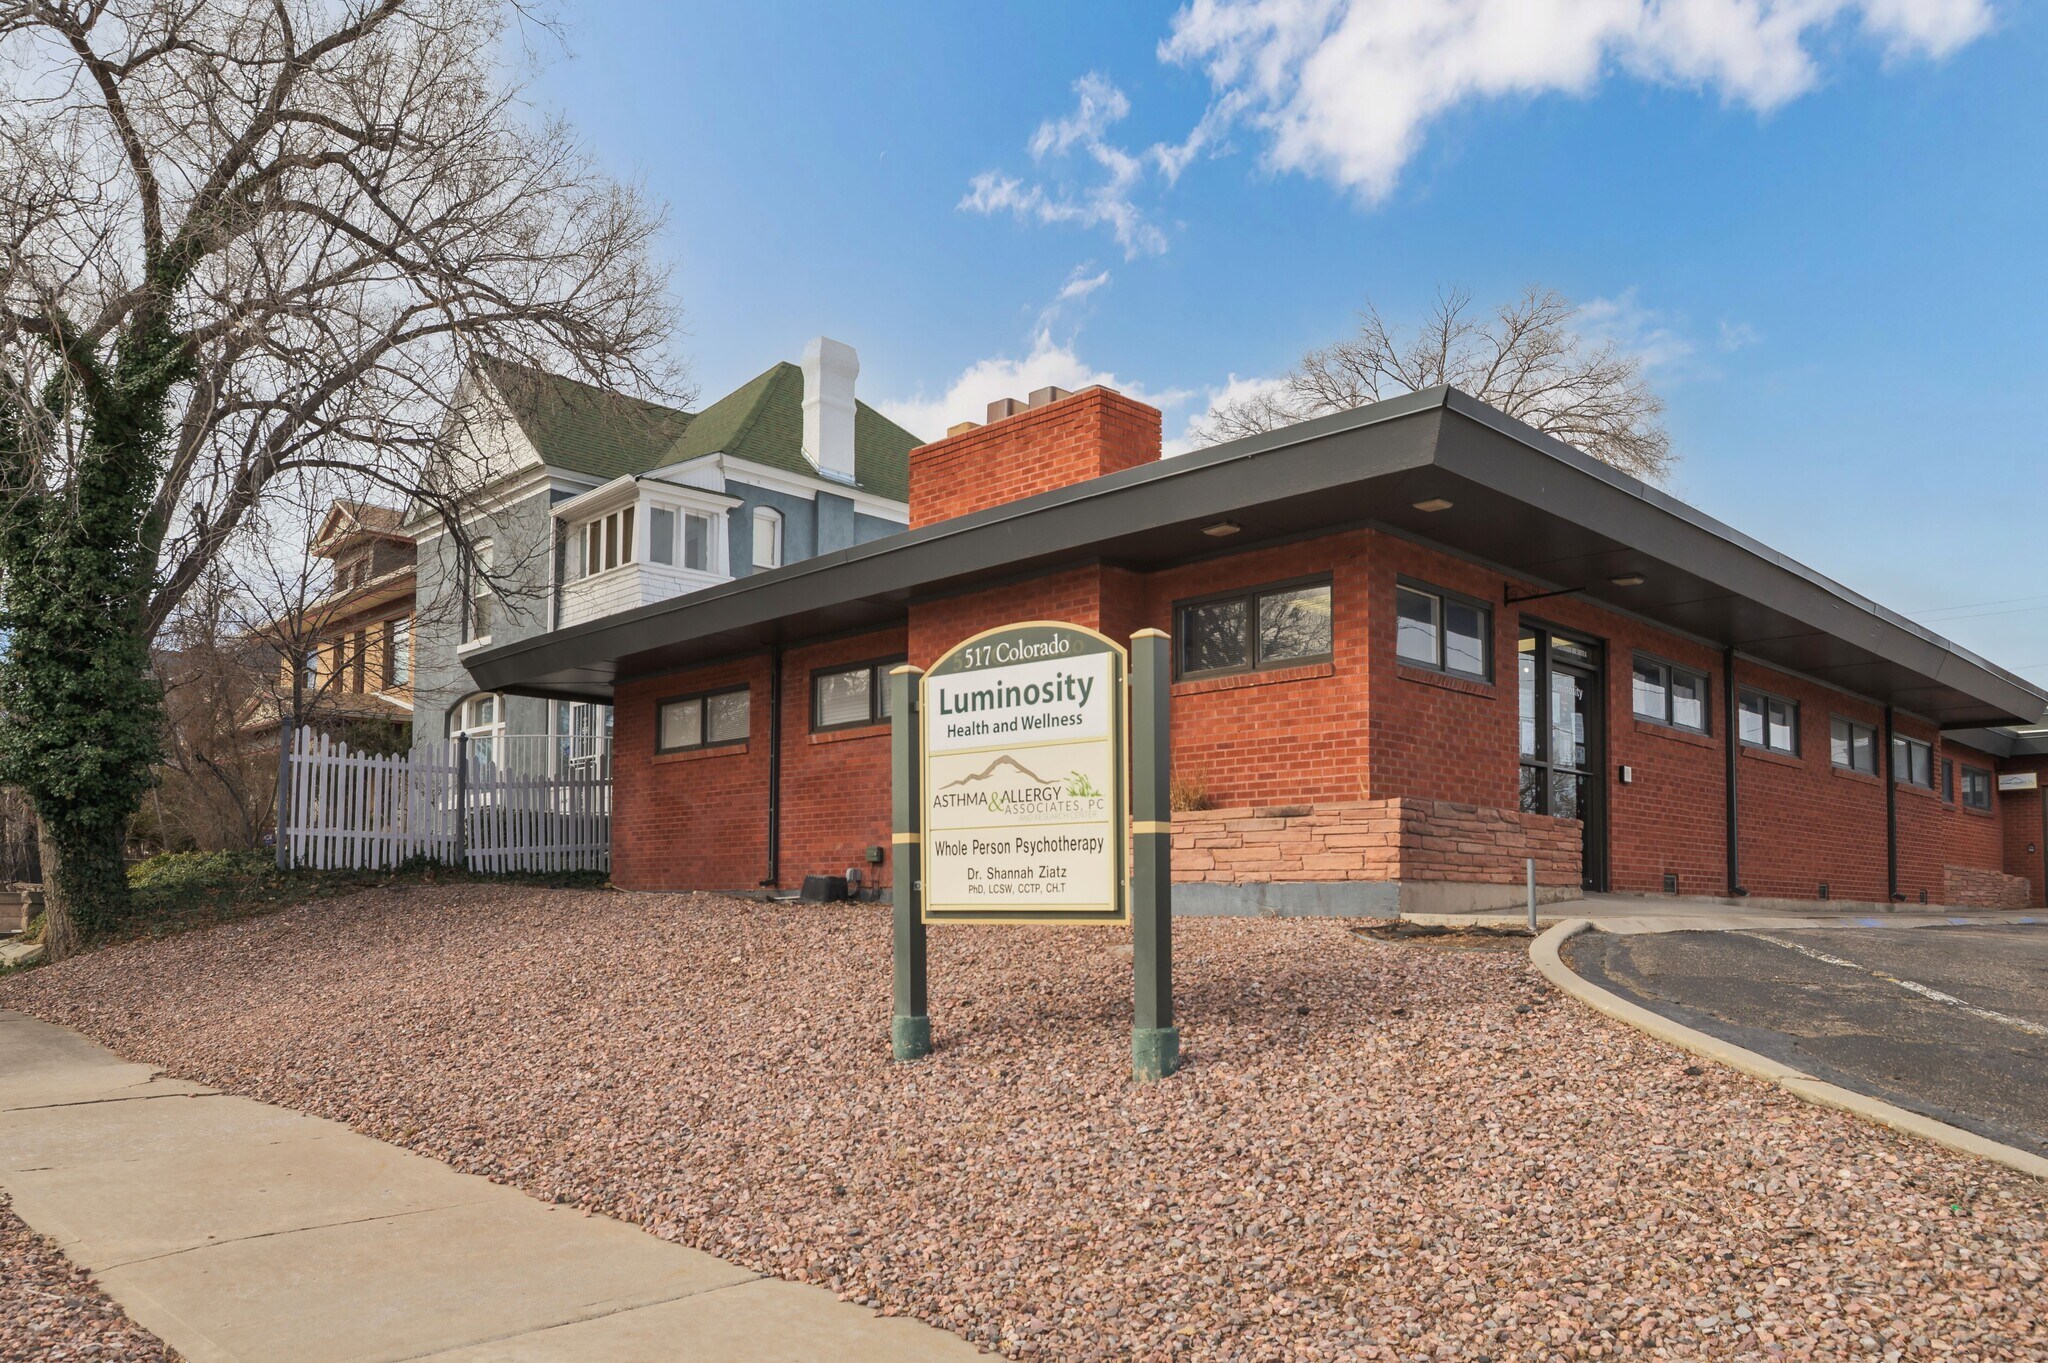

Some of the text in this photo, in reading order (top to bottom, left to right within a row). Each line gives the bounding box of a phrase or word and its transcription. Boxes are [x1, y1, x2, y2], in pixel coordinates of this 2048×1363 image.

[965, 633, 1070, 669] 517 Colorado
[940, 672, 1094, 715] Luminosity
[947, 713, 1083, 738] Health and Wellness
[933, 786, 1062, 812] ASTHMA & ALLERGY
[1004, 799, 1104, 815] ASSOCIATES, PC
[935, 835, 1104, 857] Whole Person Psychotherapy
[967, 865, 1067, 880] Dr. Shannah Ziatz
[968, 884, 986, 895] PhD,
[989, 883, 1015, 894] LCSW,
[1018, 883, 1042, 894] CCTP,
